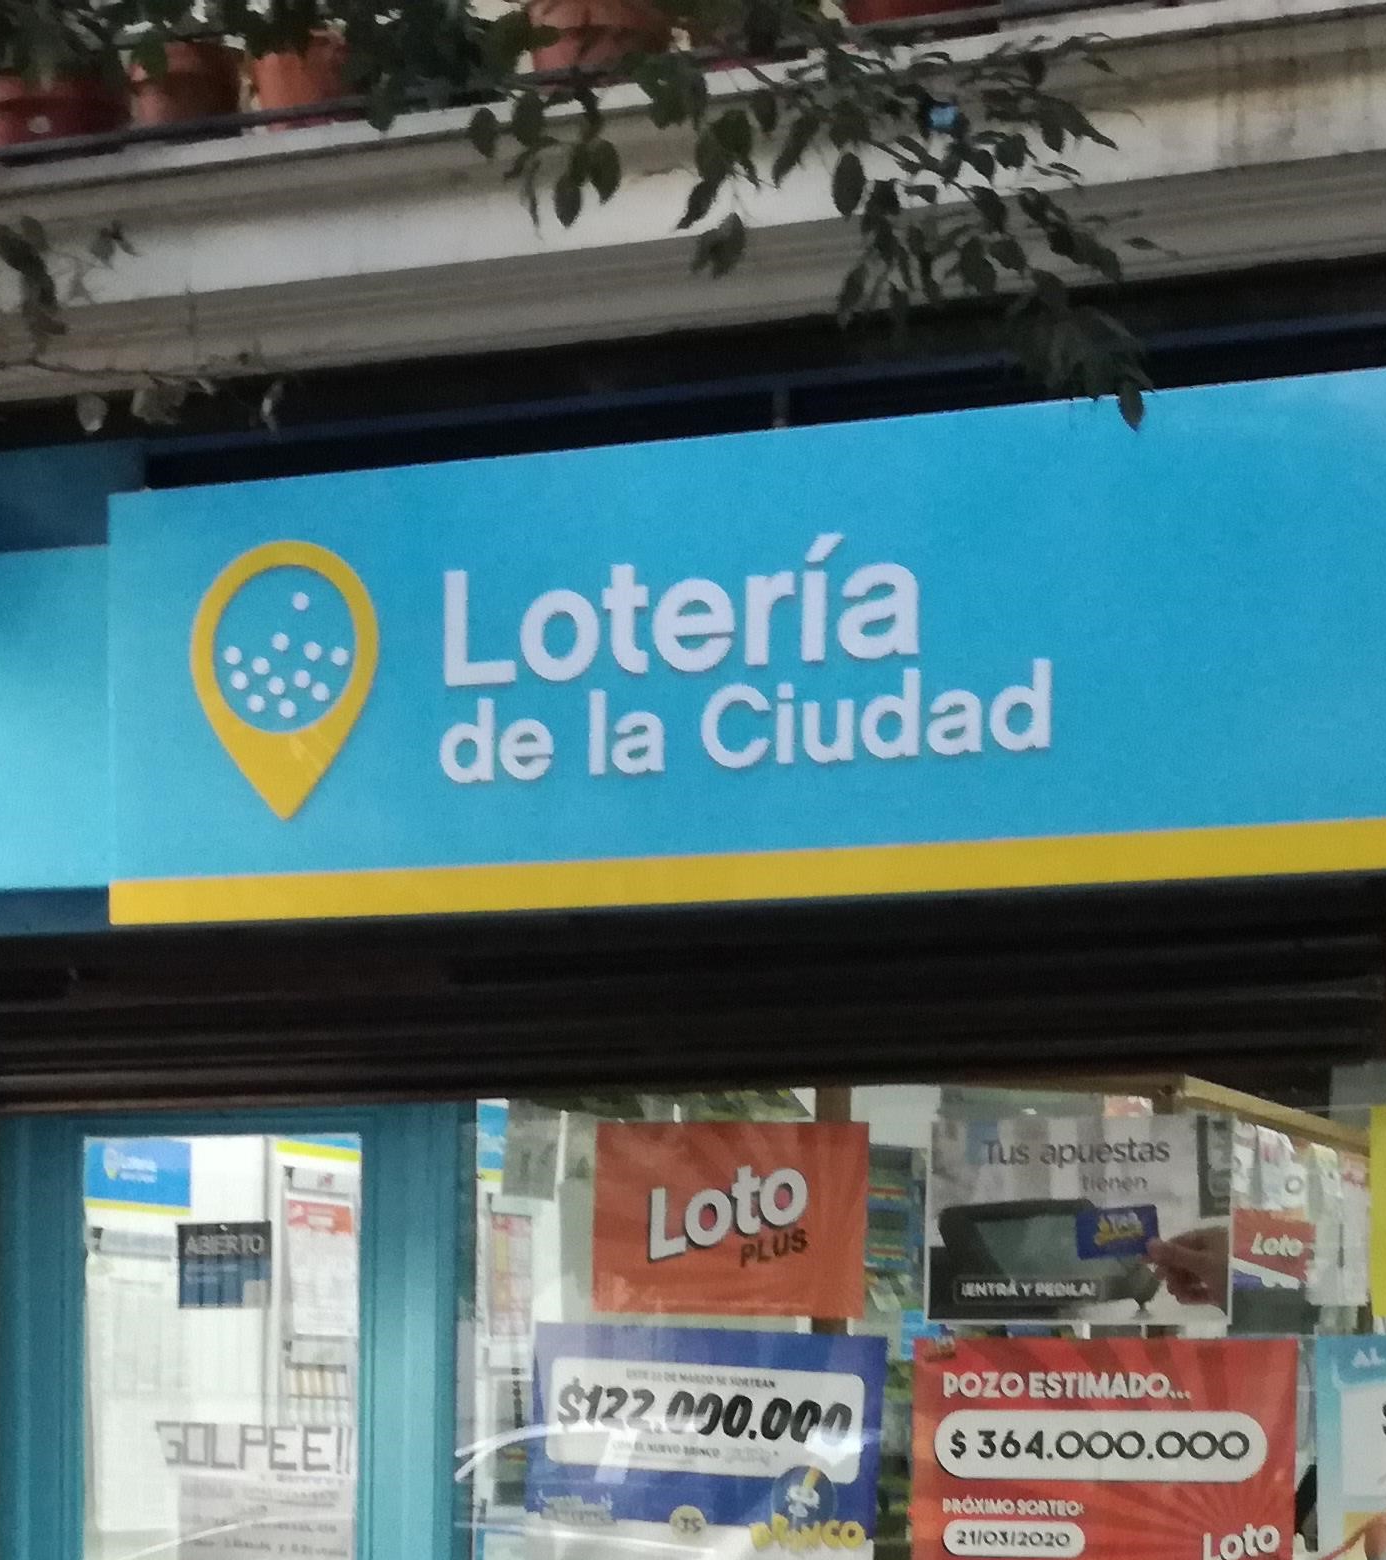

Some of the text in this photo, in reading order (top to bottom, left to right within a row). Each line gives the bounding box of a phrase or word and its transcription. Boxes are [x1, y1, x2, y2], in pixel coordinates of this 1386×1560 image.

[442, 532, 920, 687] Lotería
[439, 657, 1052, 785] de la Ciudad
[982, 1136, 1171, 1168] Tus apuestas
[647, 1165, 809, 1263] Loto
[740, 1228, 809, 1267] PLUS
[557, 1376, 854, 1444] $122.000.000
[943, 1371, 1192, 1400] POZO ESTIMADO...
[949, 1429, 1250, 1460] $ 364.000.000
